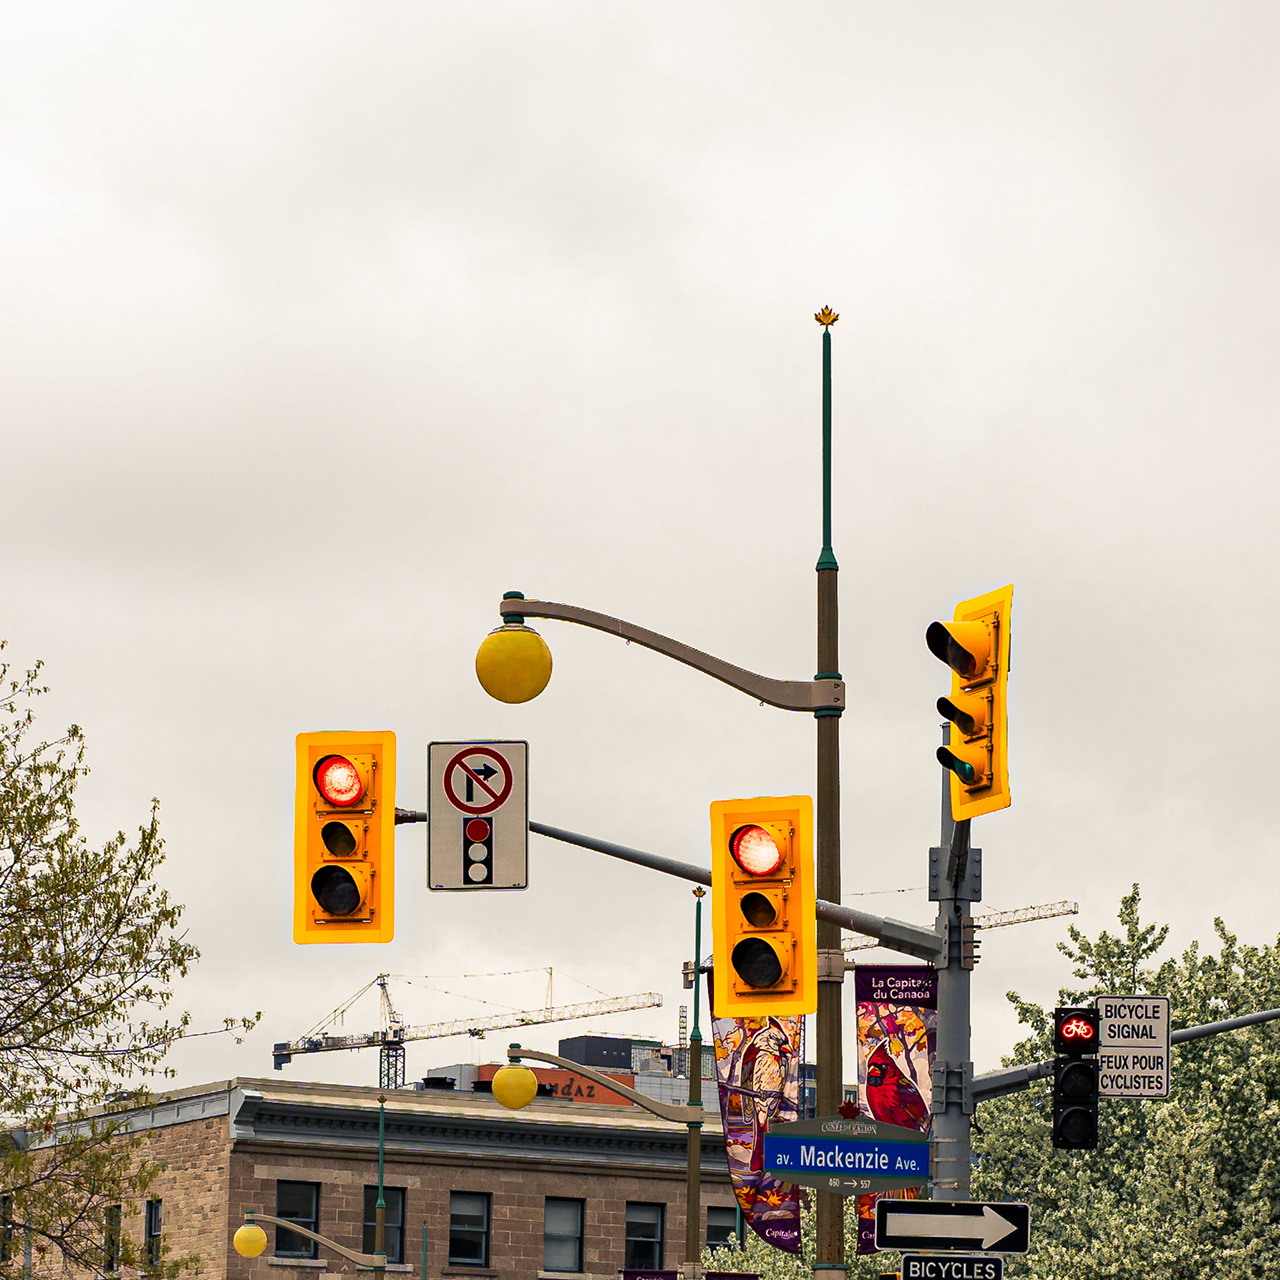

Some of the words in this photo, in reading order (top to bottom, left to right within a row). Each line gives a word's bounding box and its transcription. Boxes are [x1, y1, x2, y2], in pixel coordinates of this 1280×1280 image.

[871, 977, 884, 988] La
[873, 989, 887, 999] du
[1104, 1003, 1160, 1020] BICYCLE
[1107, 1023, 1157, 1039] SIGNAL
[1100, 1054, 1129, 1070] FEUX
[1131, 1055, 1164, 1070] POUR
[1100, 1073, 1163, 1090] CYCLISTES
[776, 1154, 793, 1166] av.
[800, 1145, 889, 1169] Mackenzie
[895, 1156, 920, 1171] Ave.
[909, 1261, 996, 1279] BICYCLES
